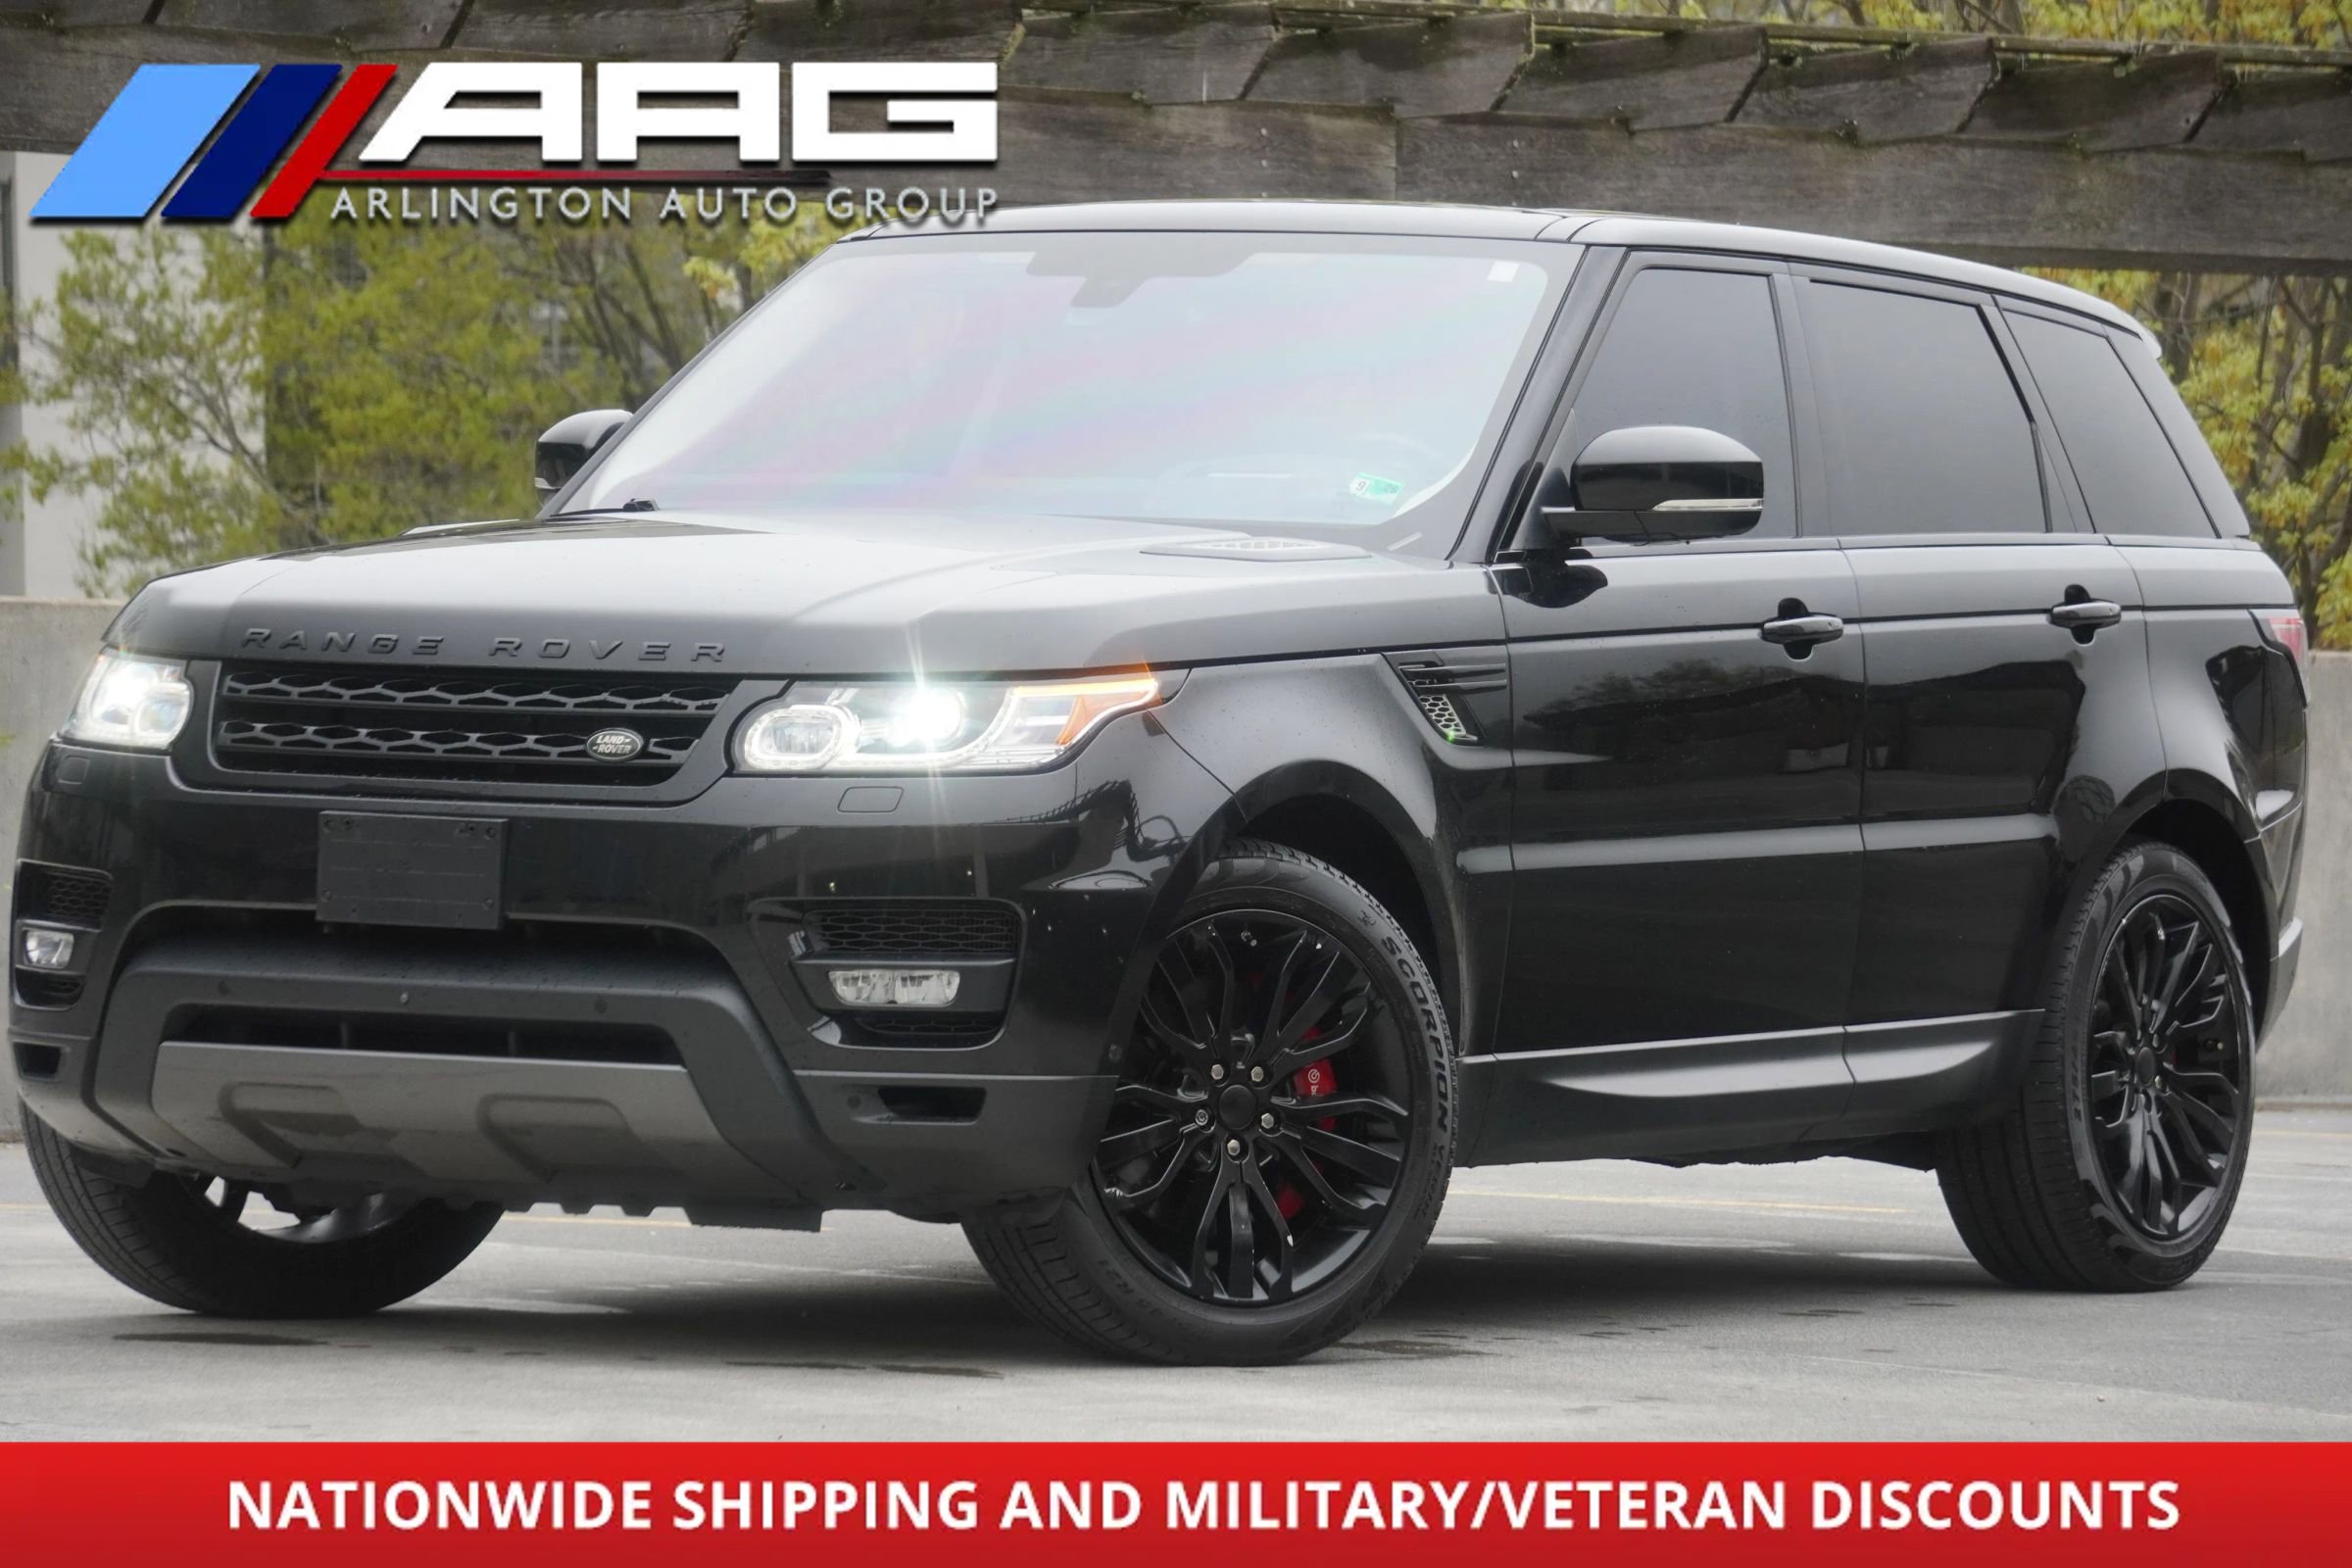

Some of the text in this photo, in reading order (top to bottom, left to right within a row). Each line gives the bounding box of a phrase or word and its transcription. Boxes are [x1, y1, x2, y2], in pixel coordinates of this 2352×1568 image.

[239, 626, 727, 662] RANGE ROVER
[596, 735, 624, 744] LAND
[597, 745, 631, 754] ROVER
[1381, 936, 1447, 1133] SCORPION
